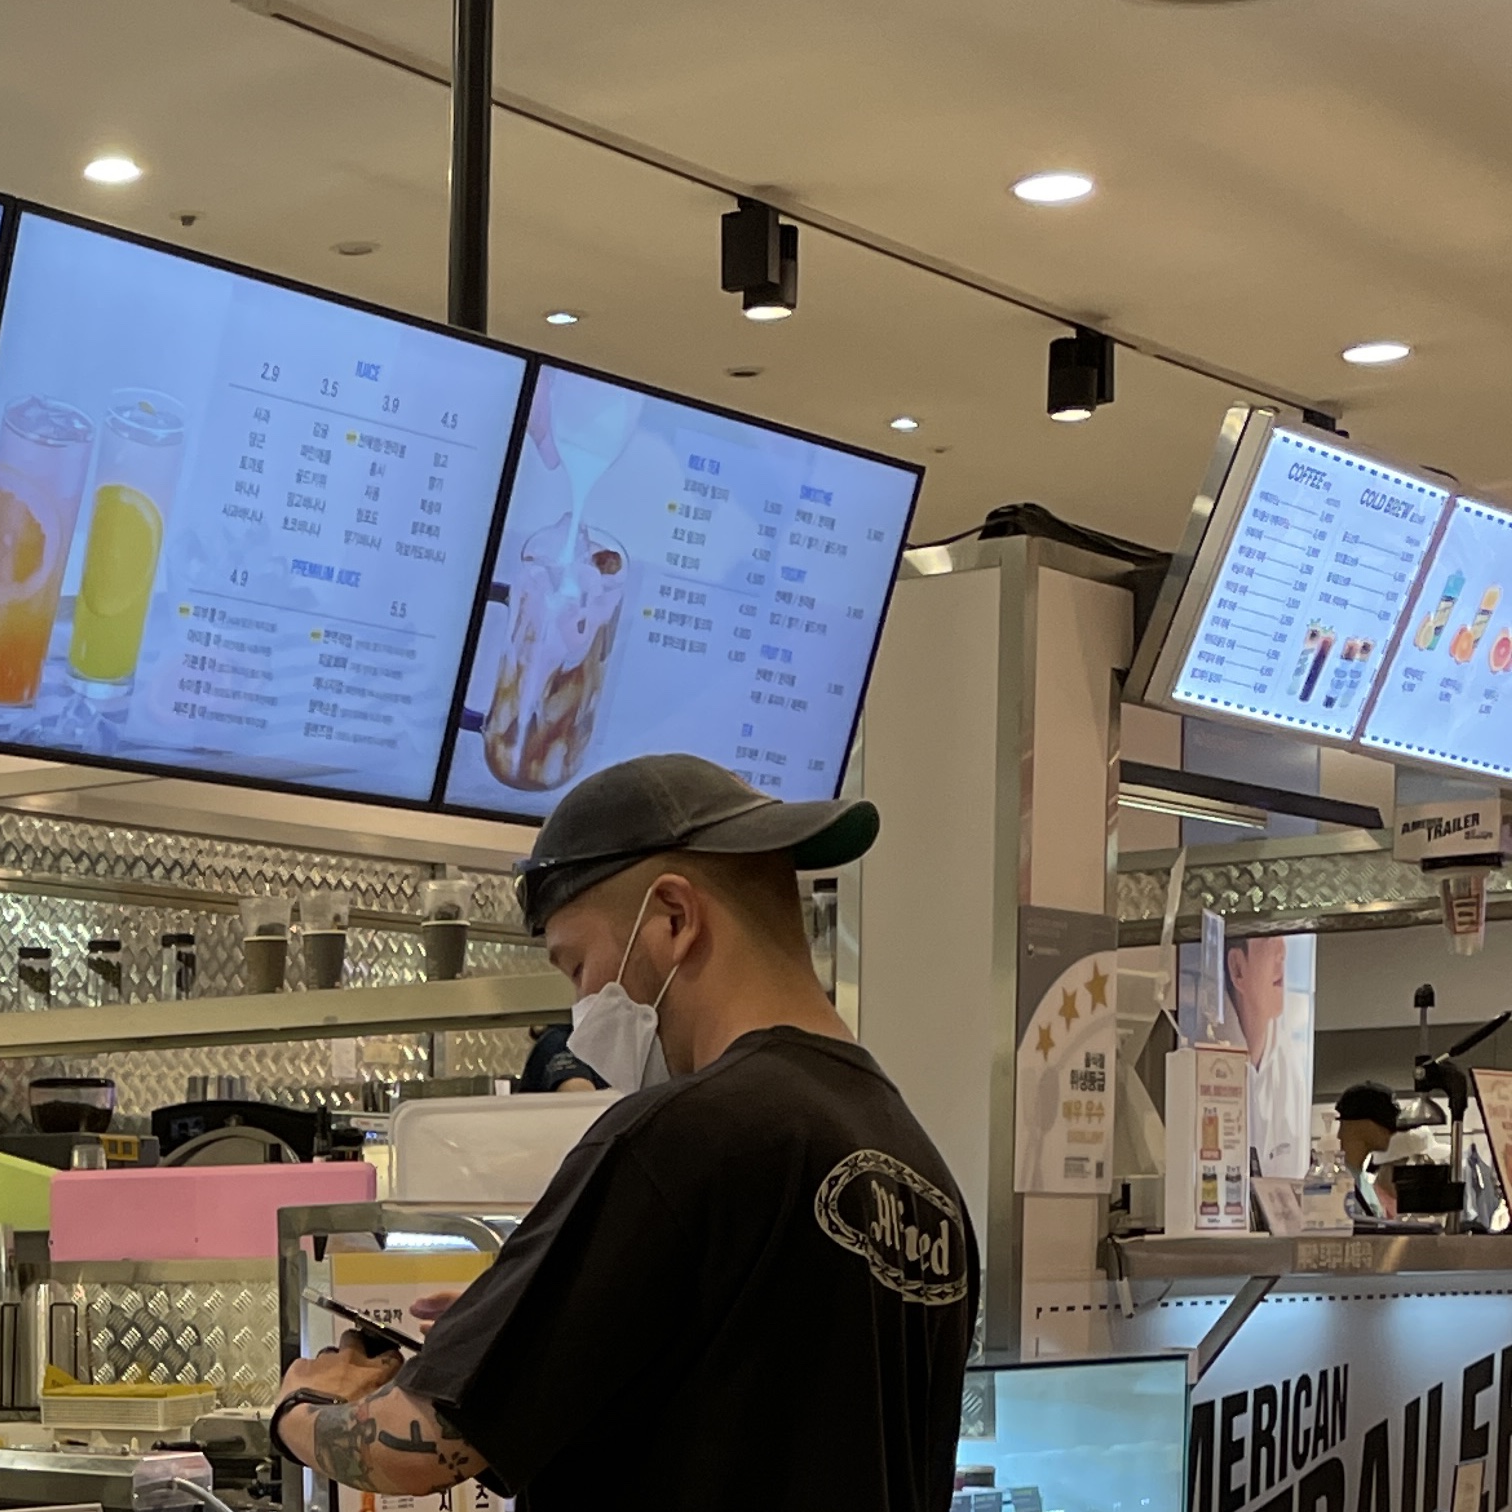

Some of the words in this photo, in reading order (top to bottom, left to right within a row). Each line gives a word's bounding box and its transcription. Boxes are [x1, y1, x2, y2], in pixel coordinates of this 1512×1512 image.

[260, 362, 280, 383] 2.9
[320, 378, 339, 398] 3.5
[382, 394, 400, 414] 3.9
[440, 411, 458, 430] 4.5
[1288, 462, 1328, 490] COFFEE
[1360, 488, 1386, 511] COLD
[1384, 494, 1415, 520] BREW
[230, 569, 249, 588] 4.9
[390, 600, 407, 619] 5.5
[1427, 812, 1480, 842] TRAILER
